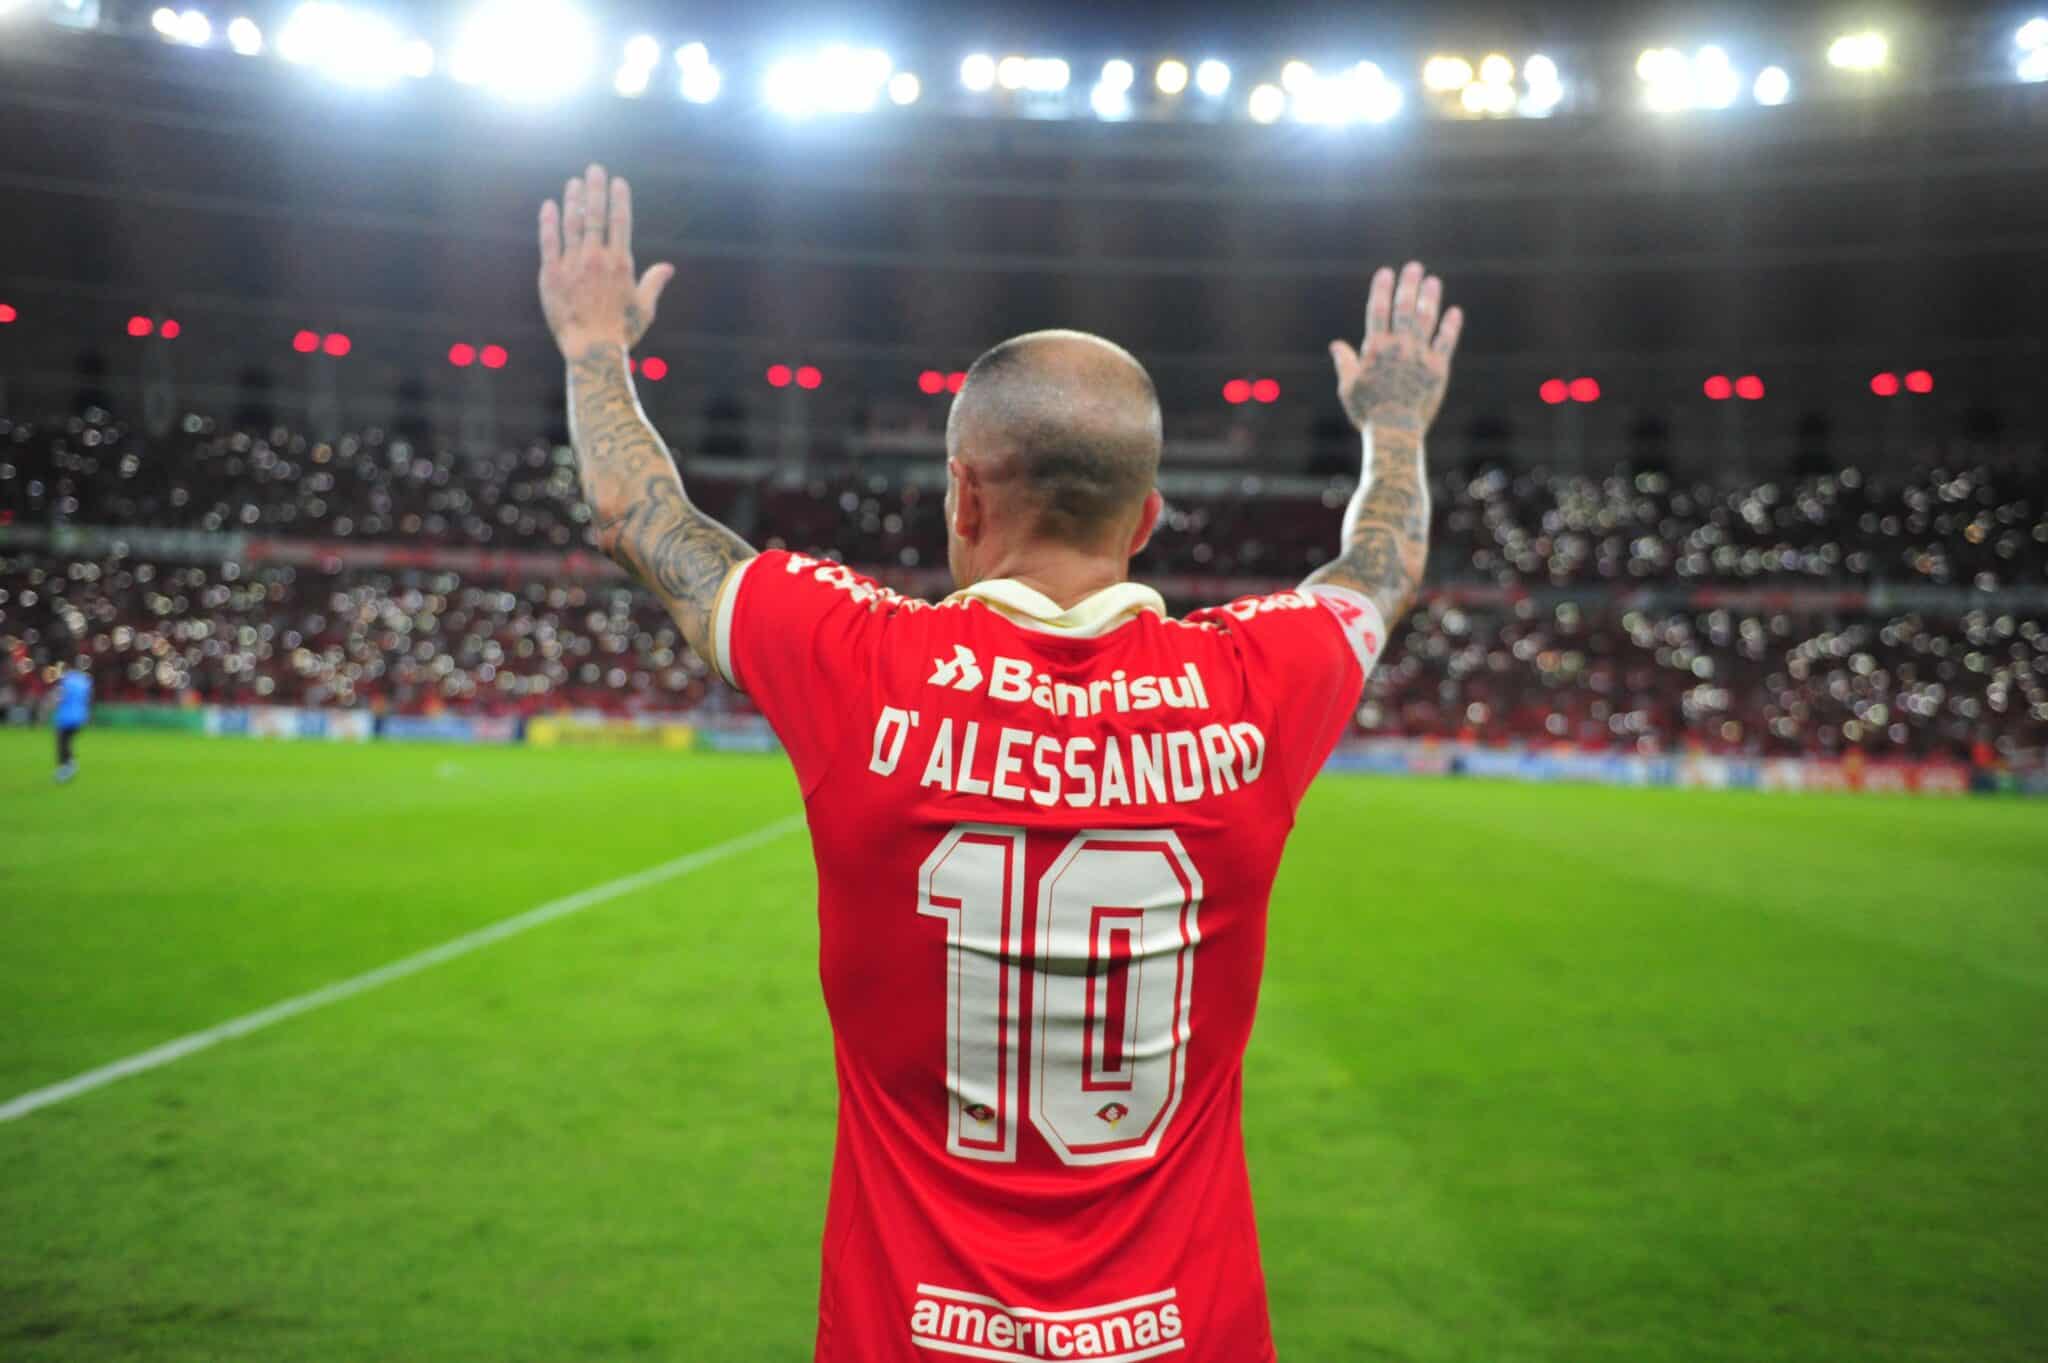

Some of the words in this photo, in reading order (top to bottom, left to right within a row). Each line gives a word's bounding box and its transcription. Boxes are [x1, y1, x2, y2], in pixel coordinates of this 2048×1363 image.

[988, 656, 1209, 717] Banrisul
[917, 823, 1203, 1166] 10
[911, 1299, 1182, 1357] americanas
